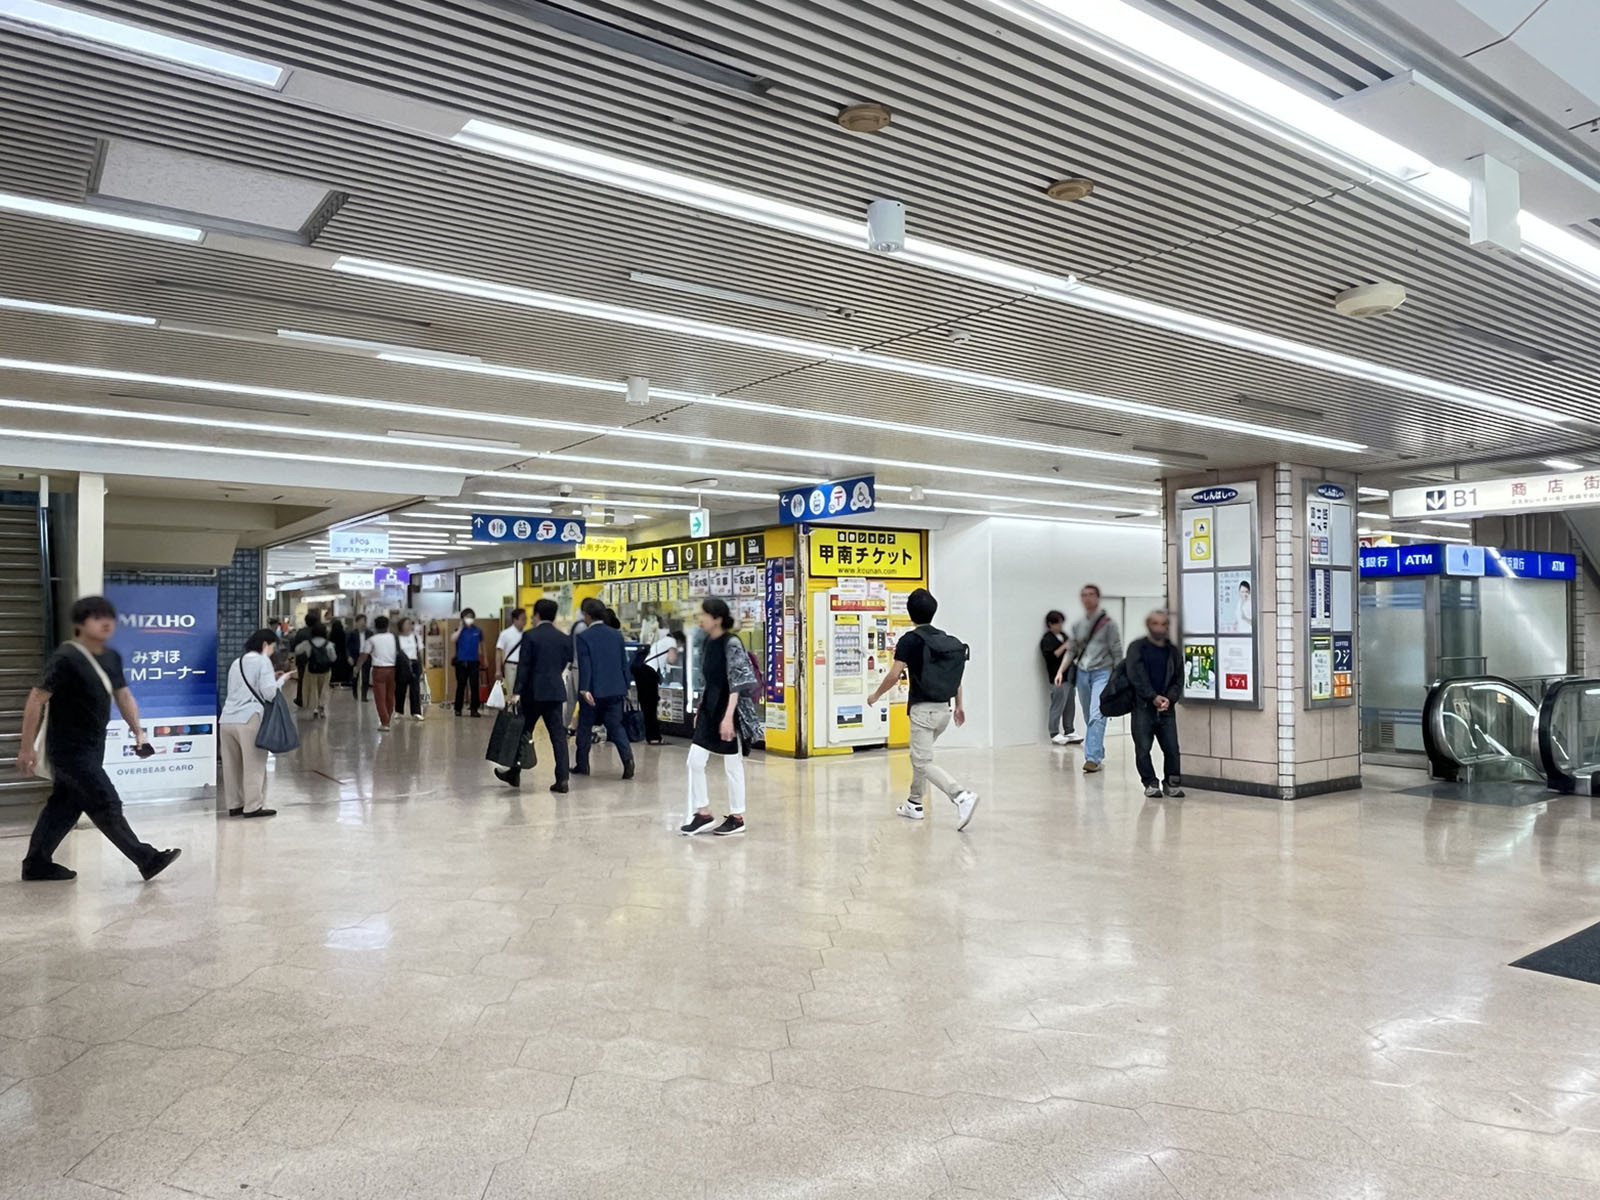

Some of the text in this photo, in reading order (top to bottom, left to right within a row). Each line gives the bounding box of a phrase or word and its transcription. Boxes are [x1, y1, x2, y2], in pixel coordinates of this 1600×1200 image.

[1454, 488, 1478, 507] B1
[819, 544, 912, 565] 甲南チケット
[1405, 554, 1433, 566] ATM
[838, 567, 897, 575] www.kounan.com
[1552, 560, 1565, 572] ATM
[118, 613, 195, 628] MIZUHO
[131, 650, 181, 664] みずほ
[1229, 679, 1245, 687] 171
[117, 764, 194, 776] OVERSEAS CARD
